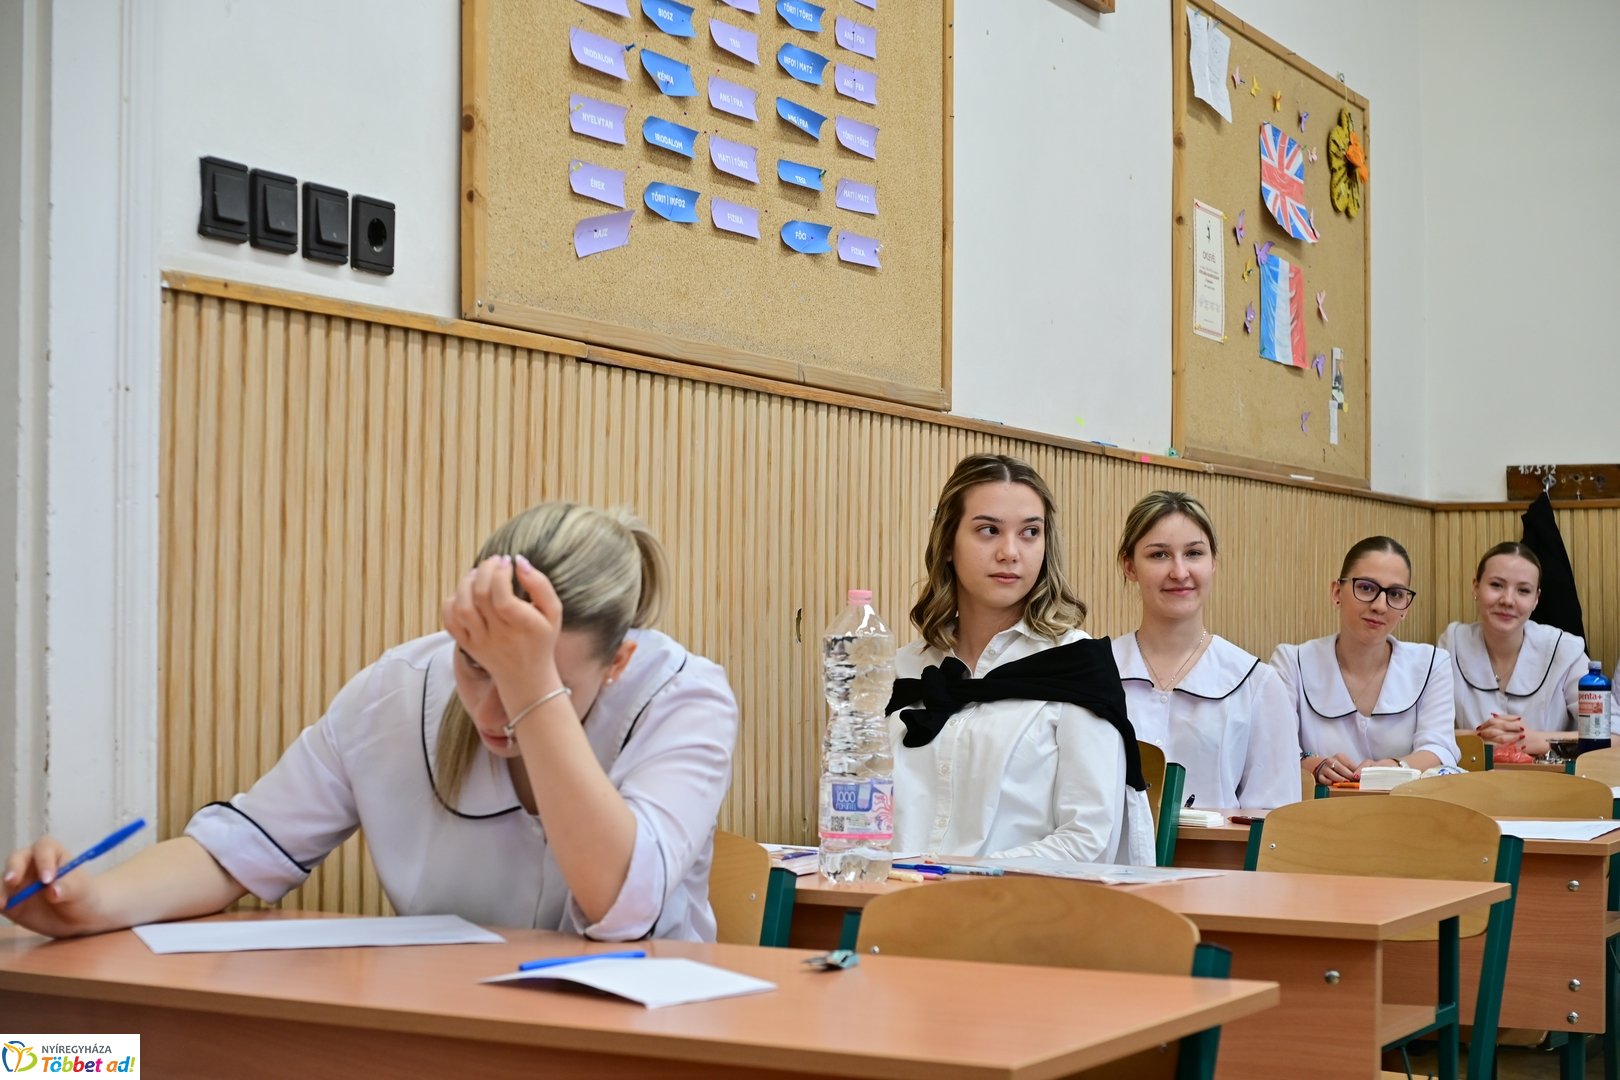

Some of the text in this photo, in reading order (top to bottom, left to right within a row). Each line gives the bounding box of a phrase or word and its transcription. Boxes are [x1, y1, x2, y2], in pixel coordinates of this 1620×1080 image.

[657, 8, 674, 22] BIOSZ
[856, 34, 865, 45] FRA
[583, 47, 614, 65] IRODALOM
[799, 61, 813, 74] MAT2
[657, 71, 674, 85] KÉMIA
[856, 82, 865, 92] FRA
[719, 92, 744, 109] ANG FRA
[582, 112, 613, 129] NYELVTAN
[799, 117, 809, 129] FRA
[654, 132, 683, 150] IRODALOM
[590, 176, 605, 191] ÉNEK
[669, 196, 686, 209] INFO2
[727, 213, 744, 225] FIZIKA
[593, 228, 608, 239] RAJZ
[851, 246, 866, 258] FIZIKA
[837, 791, 856, 803] 1000
